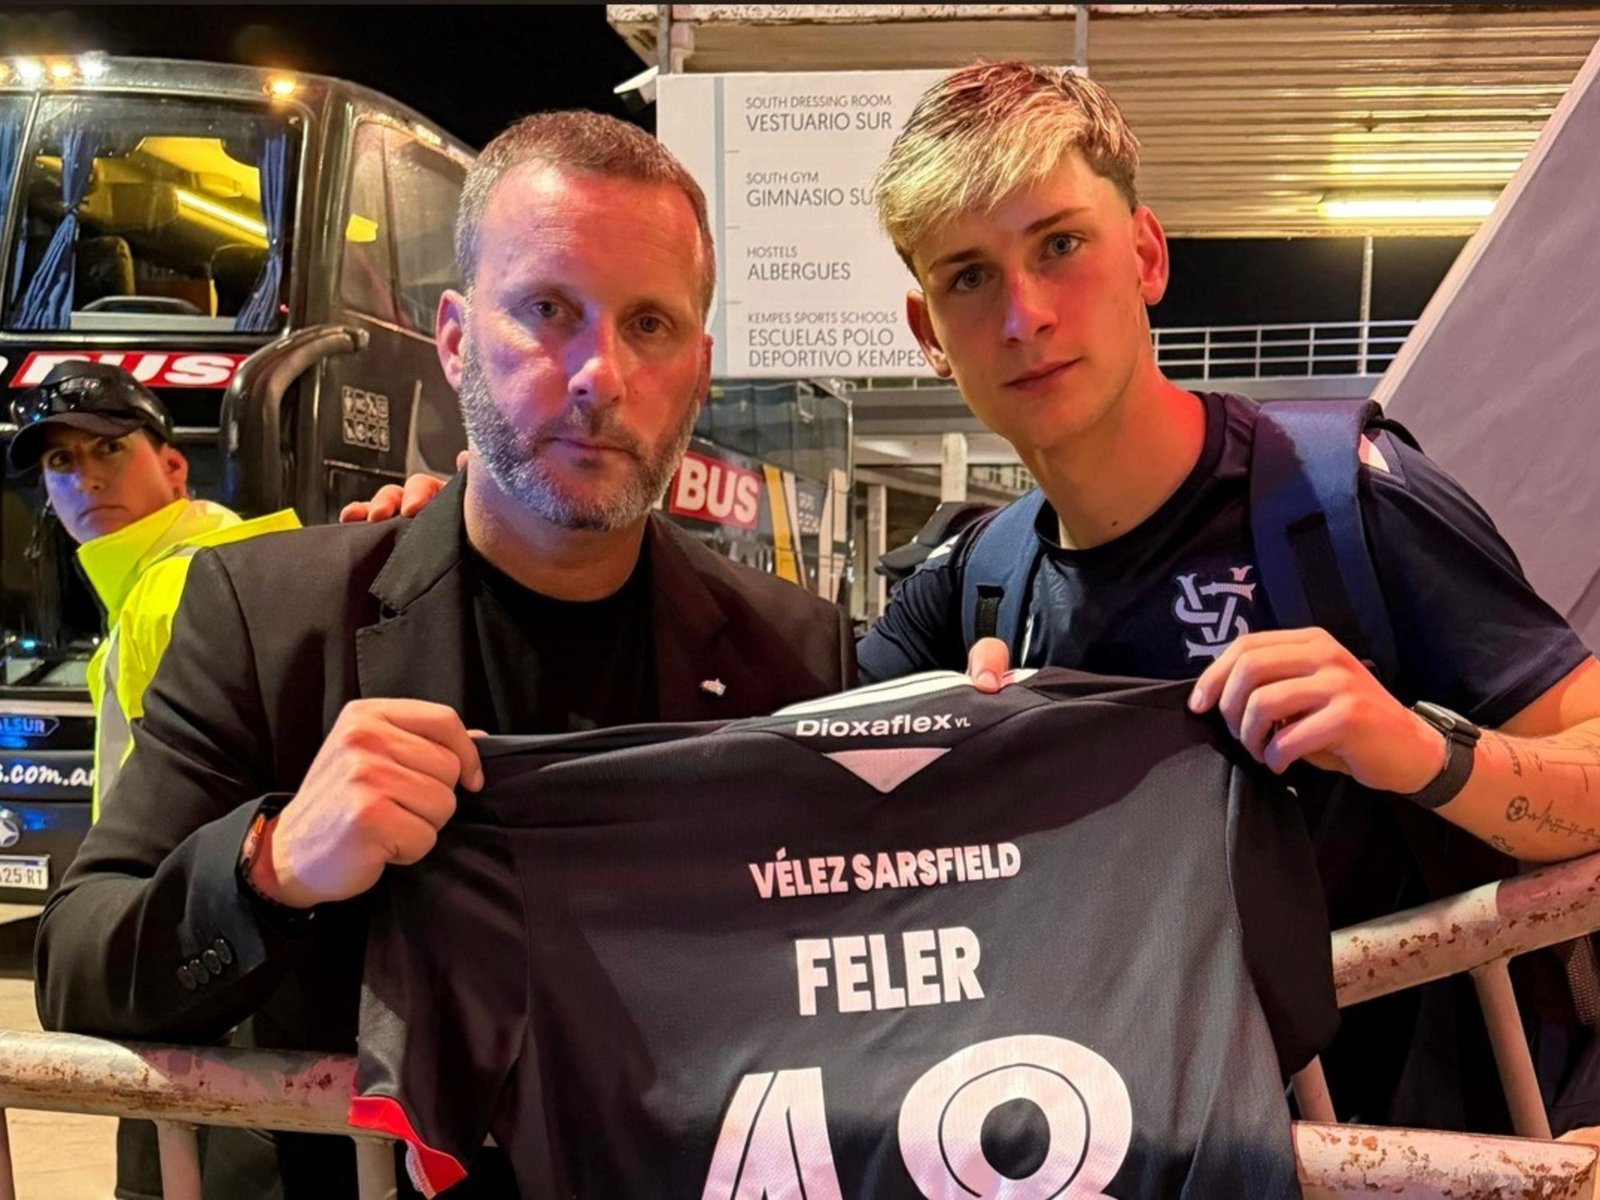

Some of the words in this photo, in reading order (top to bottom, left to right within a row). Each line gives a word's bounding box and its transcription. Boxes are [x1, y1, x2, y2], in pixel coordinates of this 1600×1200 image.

[746, 96, 788, 109] SOUTH
[790, 95, 848, 108] DRESSING
[850, 94, 892, 107] ROOM
[746, 112, 851, 132] VESTUARIO
[855, 111, 892, 130] SUR
[746, 172, 788, 185] SOUTH
[790, 171, 819, 184] GYM
[746, 188, 844, 207] GIMNASIO
[850, 187, 873, 206] SU
[747, 246, 798, 259] HOSTELS
[748, 262, 852, 281] ALBERGUES
[748, 312, 792, 324] KEMPES
[794, 311, 838, 324] SPORTS
[840, 311, 898, 324] SCHOOLS
[749, 329, 838, 347] ESCUELAS
[843, 328, 894, 346] POLO
[750, 350, 852, 368] DEPORTIVO
[857, 349, 927, 368] KEMPES
[674, 455, 761, 524] BUS
[795, 713, 953, 738] Dioxaflex
[954, 717, 971, 728] VL
[0, 866, 22, 884] 25
[749, 846, 849, 899] VÉLEZ
[853, 841, 1022, 891] SARSFIELD
[795, 926, 985, 1017] FELER
